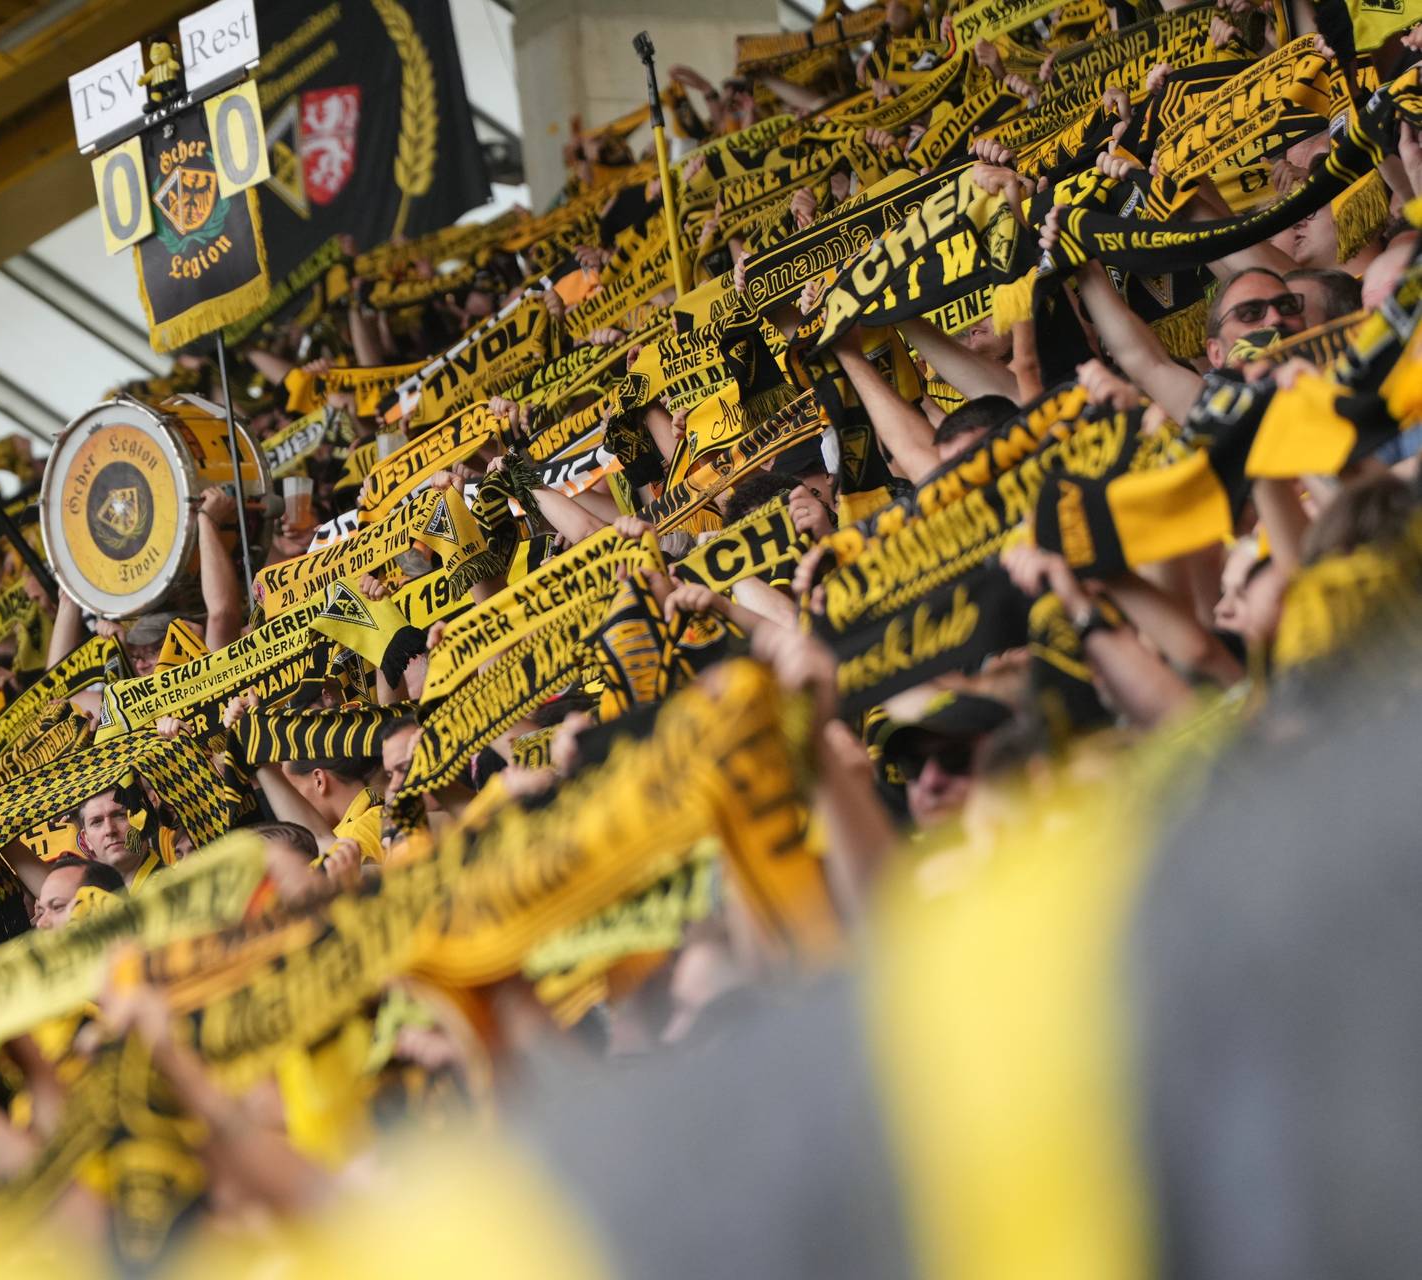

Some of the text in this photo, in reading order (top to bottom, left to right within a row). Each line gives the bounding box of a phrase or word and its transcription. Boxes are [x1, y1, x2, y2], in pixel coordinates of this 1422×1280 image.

[184, 11, 253, 69] Rest
[1290, 36, 1315, 56] GEBE
[75, 60, 140, 122] TSV
[424, 309, 541, 397] TIVOLI
[662, 354, 701, 382] MEINE
[302, 565, 347, 600] JANUAR
[350, 547, 374, 573] 2013
[446, 553, 461, 571] MIT
[120, 680, 159, 710] EINE
[160, 654, 213, 690] STADT
[227, 636, 257, 662] EIN
[260, 603, 326, 644] VEREIN
